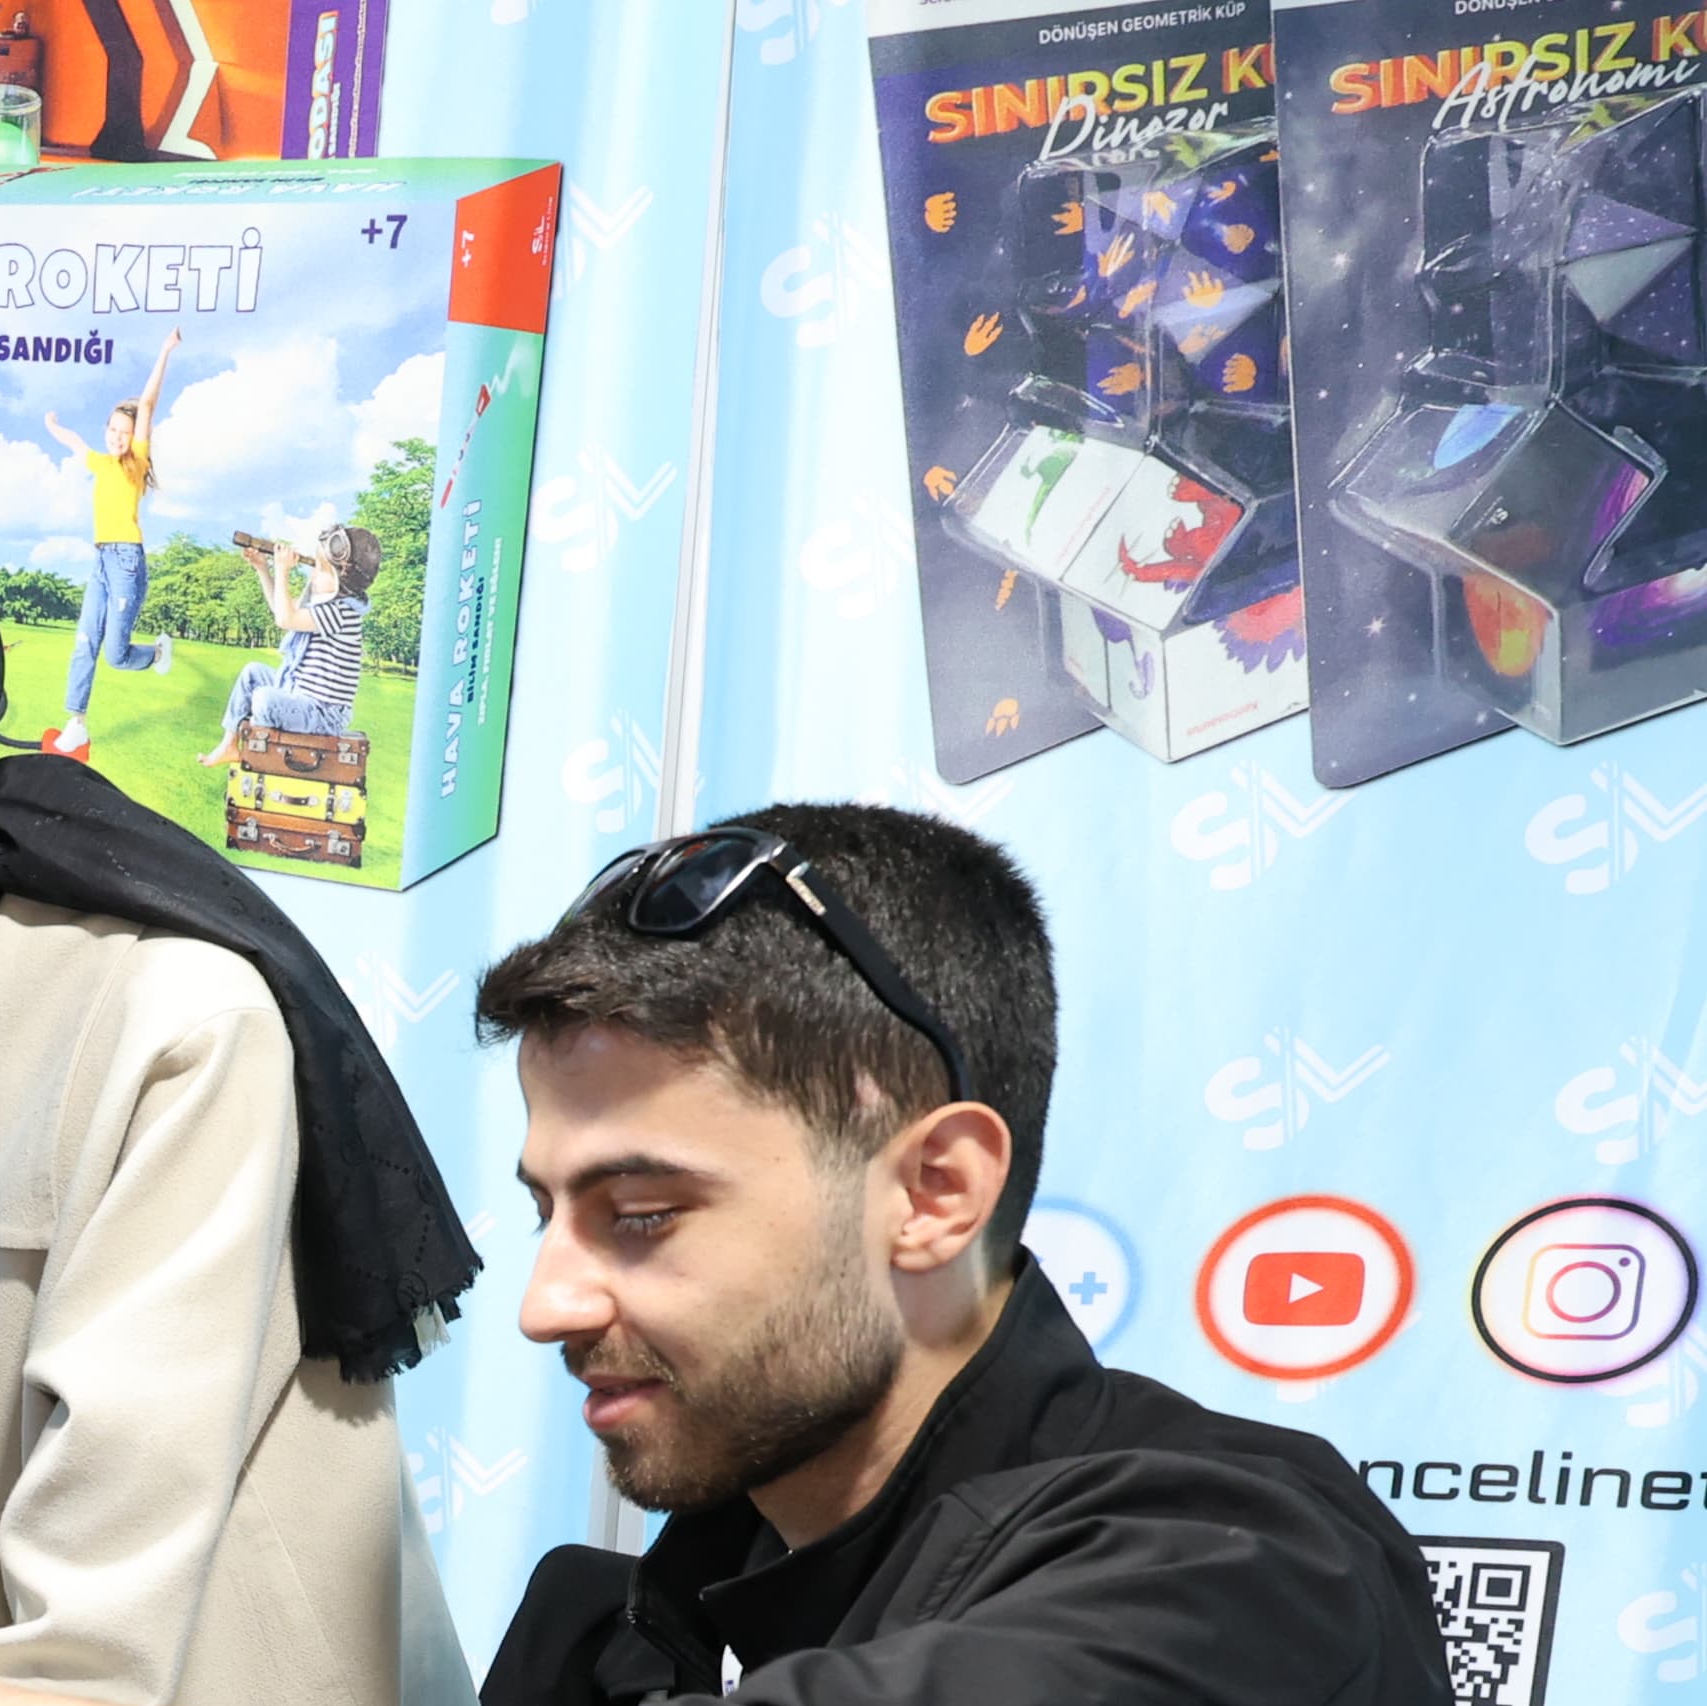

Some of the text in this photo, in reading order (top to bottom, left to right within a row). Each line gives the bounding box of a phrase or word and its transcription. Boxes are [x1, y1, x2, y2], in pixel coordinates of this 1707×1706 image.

[1039, 2, 1247, 44] DÖNÜŞEN GEOMETRİK KÜP
[1651, 11, 1707, 62] K
[1223, 40, 1275, 94] K
[1432, 53, 1701, 132] Astronomi
[1040, 94, 1229, 161] Dinozor
[360, 214, 408, 249] +7
[440, 499, 481, 799] HAVA ROKETİ
[1358, 1449, 1707, 1512] nceline
